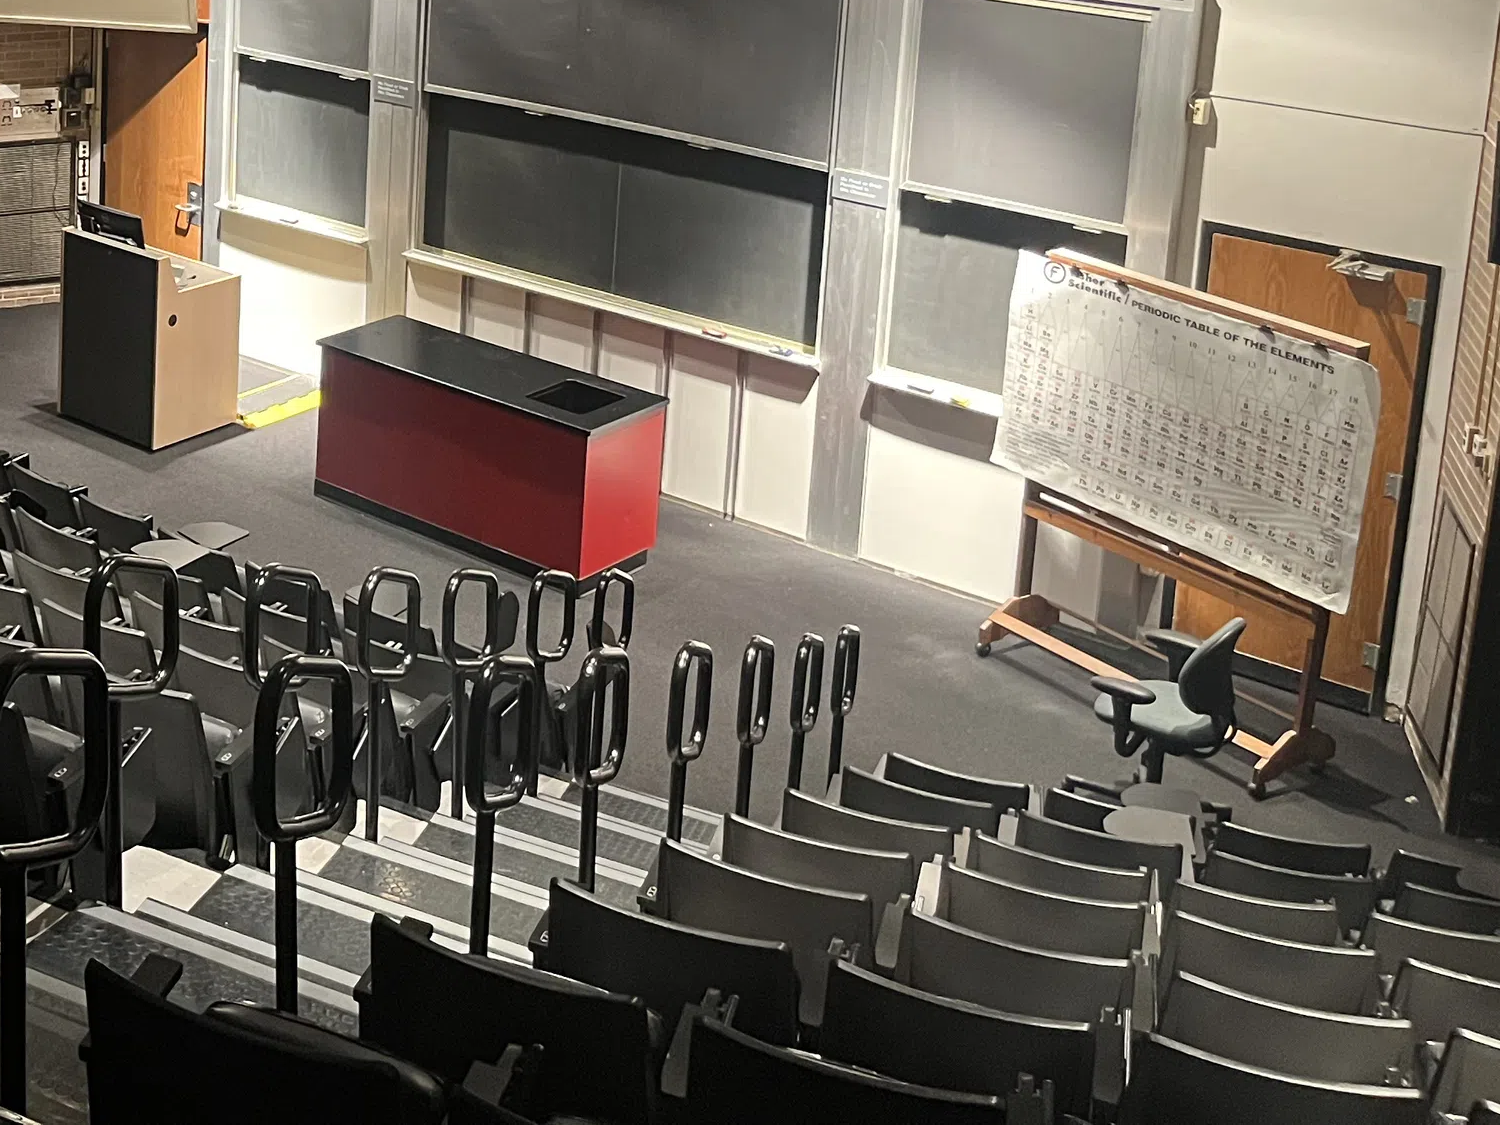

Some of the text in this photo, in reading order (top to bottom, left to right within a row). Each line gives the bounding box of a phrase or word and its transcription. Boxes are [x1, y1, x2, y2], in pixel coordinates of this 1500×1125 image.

[1068, 278, 1122, 303] Scientific
[1131, 300, 1182, 324] PERIODIC
[1184, 318, 1220, 337] TABLE
[1224, 331, 1241, 342] OF
[1243, 337, 1267, 352] THE
[1270, 347, 1335, 375] ELEMENTS
